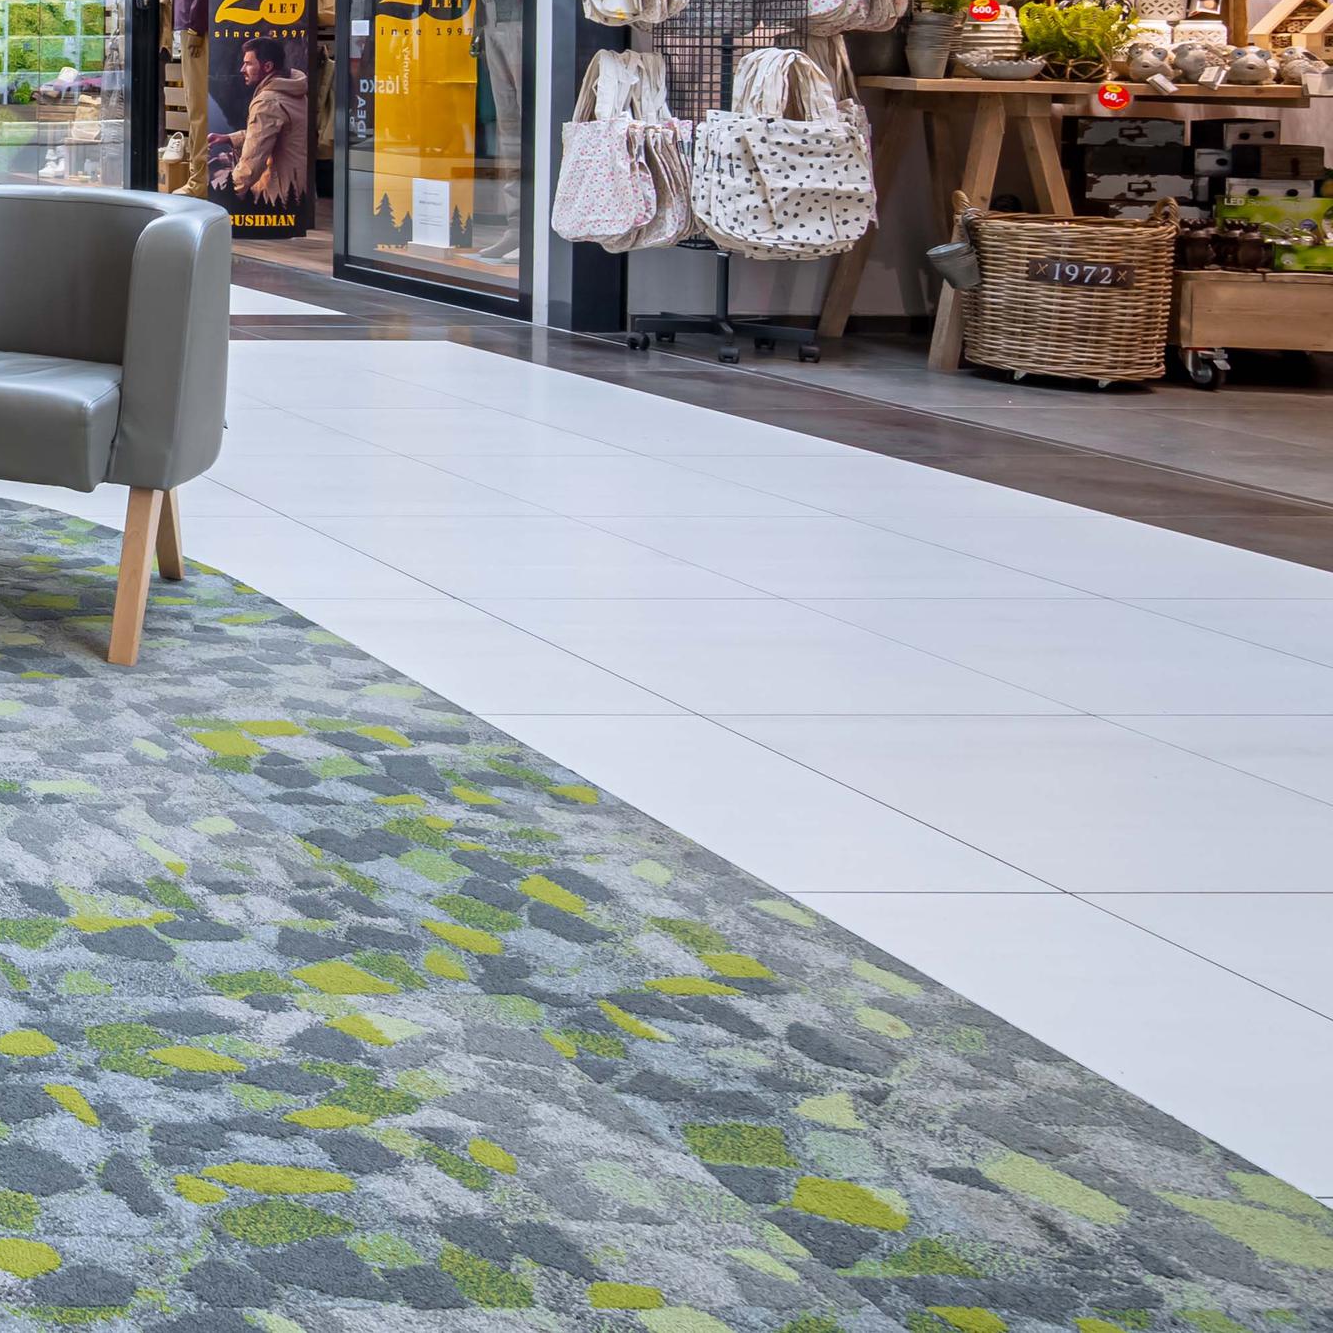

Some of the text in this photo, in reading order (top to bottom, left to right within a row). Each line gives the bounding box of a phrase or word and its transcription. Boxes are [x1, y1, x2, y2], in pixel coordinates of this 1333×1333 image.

[268, 3, 299, 14] LET
[214, 29, 306, 38] since 1997
[1224, 197, 1245, 206] LED
[1052, 262, 1113, 285] 1972
